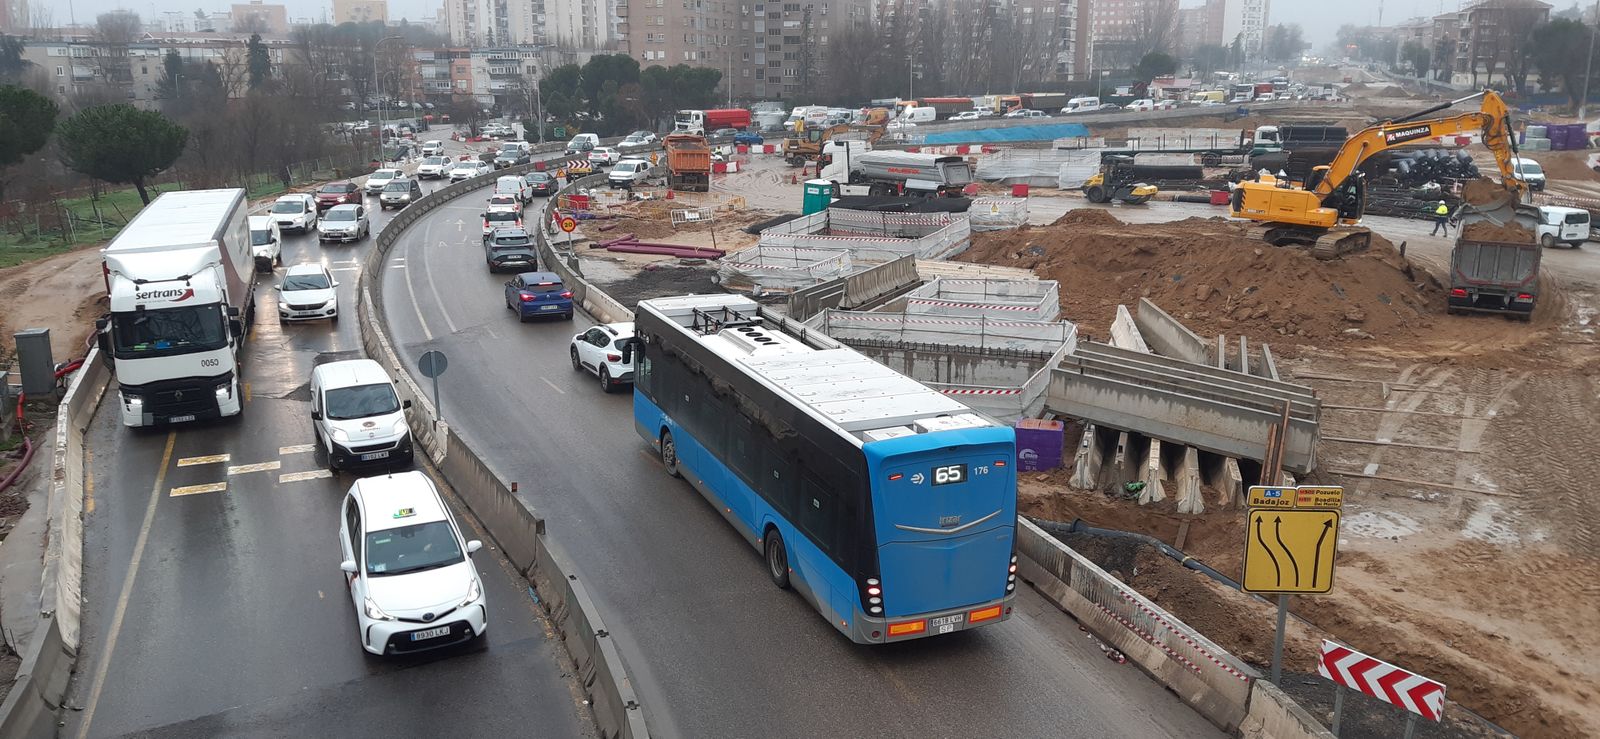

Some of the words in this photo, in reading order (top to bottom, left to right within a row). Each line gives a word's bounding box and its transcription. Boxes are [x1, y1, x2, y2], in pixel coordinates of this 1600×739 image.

[1395, 126, 1430, 138] MAQUINZA
[135, 288, 184, 301] sertrans
[936, 465, 961, 483] 65
[974, 466, 989, 476] 176
[1264, 490, 1281, 498] A-5
[1253, 497, 1290, 506] Badajoz
[941, 625, 953, 633] SP
